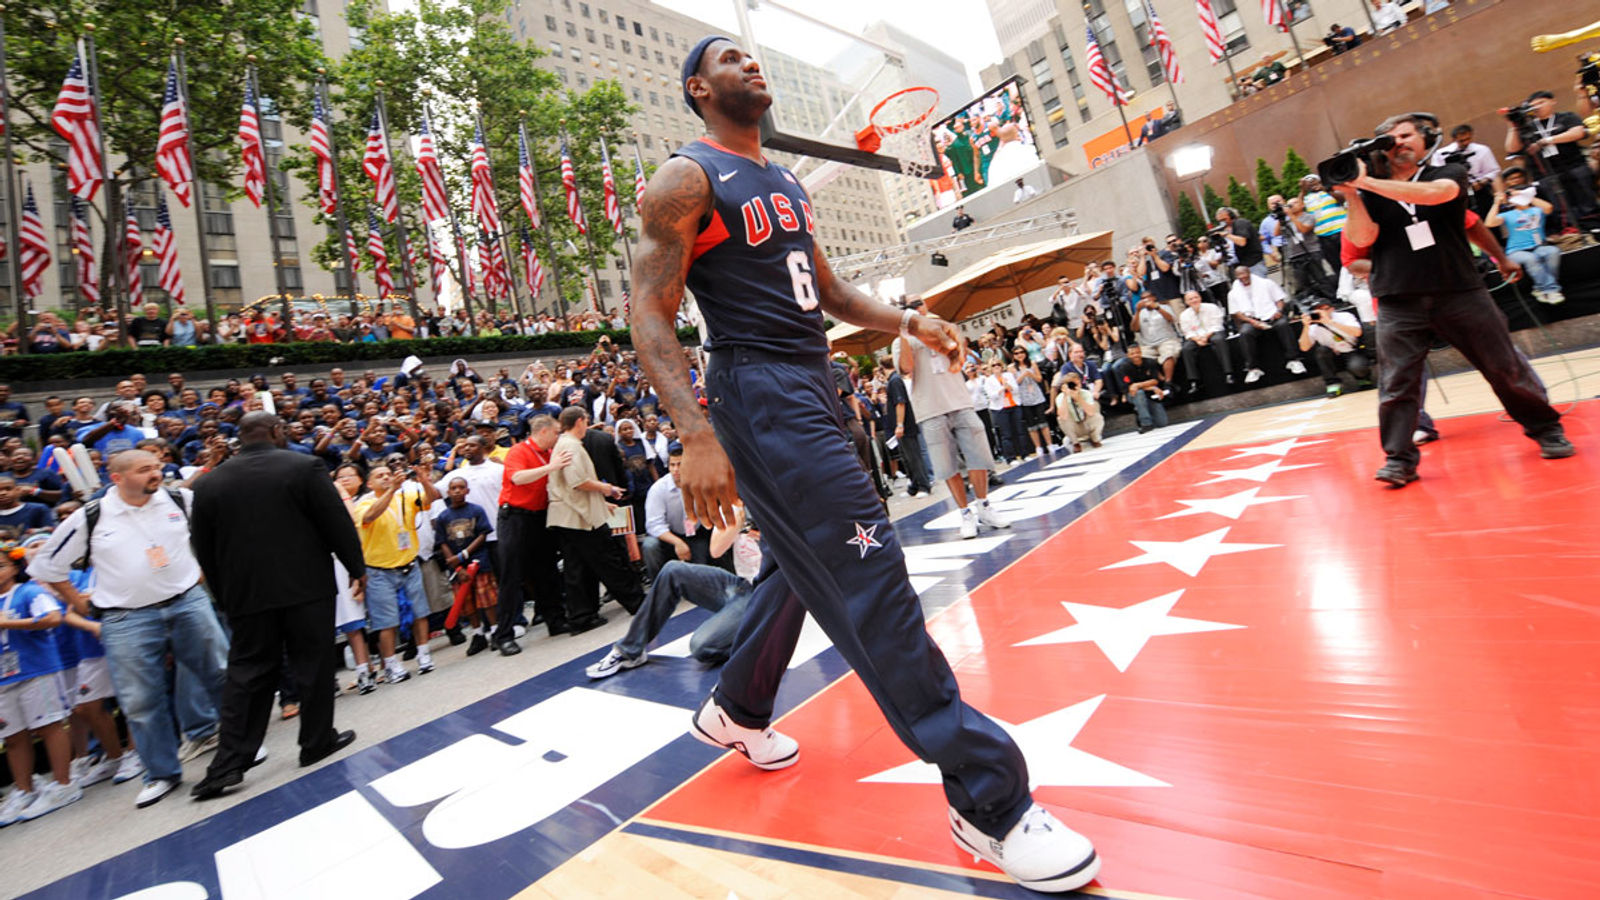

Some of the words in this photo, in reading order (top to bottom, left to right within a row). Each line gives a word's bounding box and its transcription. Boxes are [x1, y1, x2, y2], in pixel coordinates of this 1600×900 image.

[741, 192, 814, 247] USA
[786, 250, 819, 312] 6
[971, 308, 1014, 329] CETER
[922, 420, 1205, 531] ITED
[112, 686, 697, 900] RI
